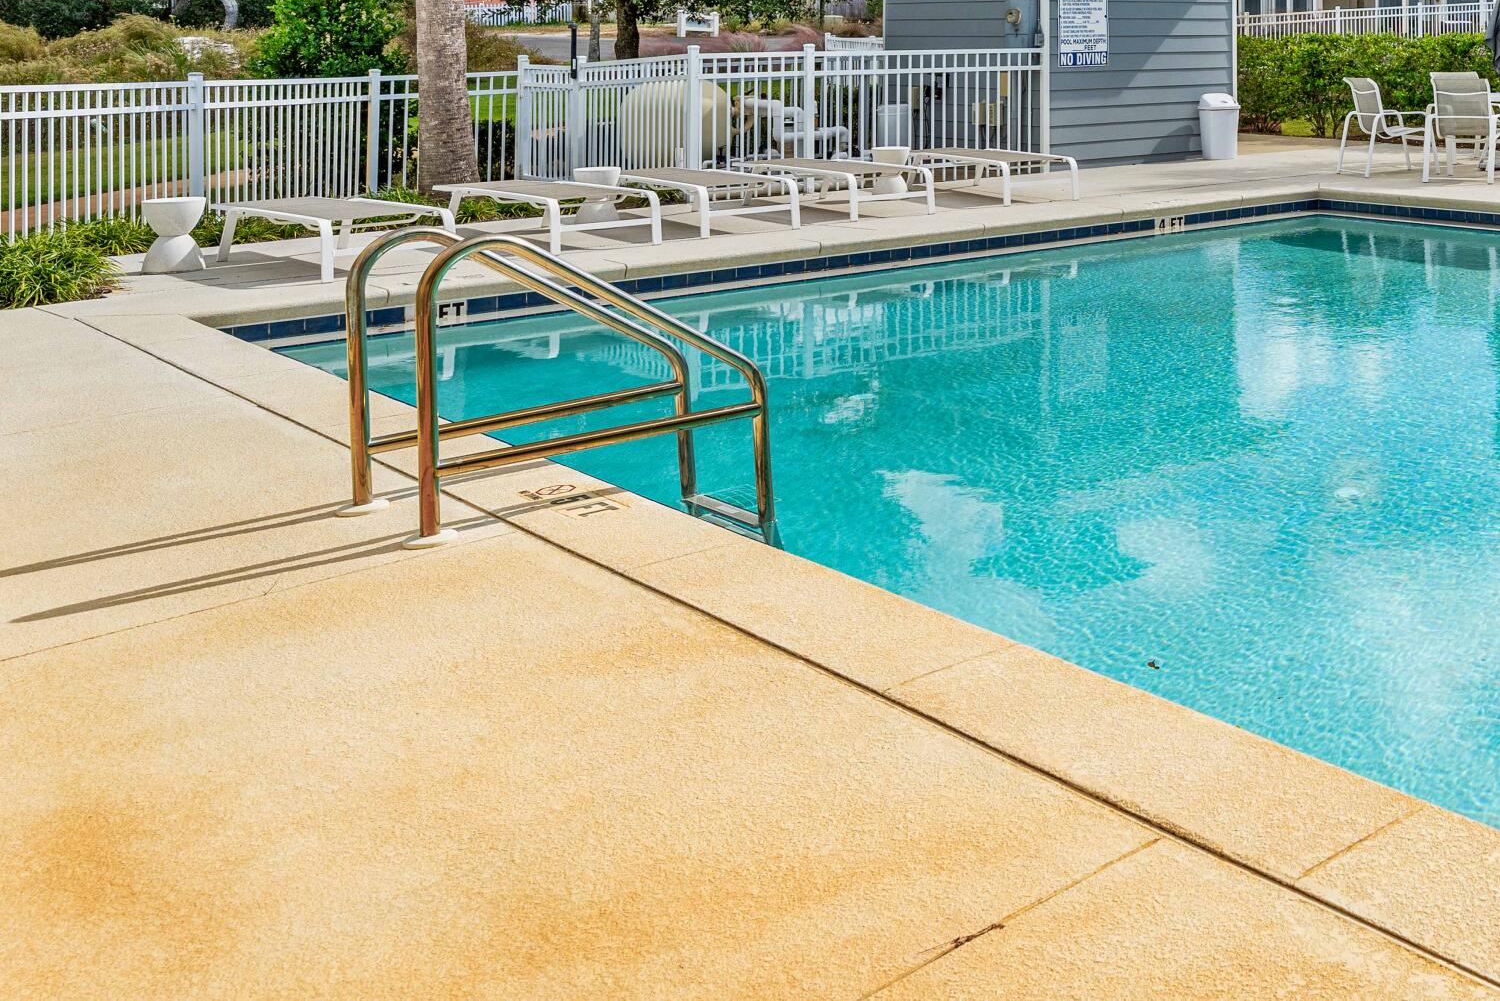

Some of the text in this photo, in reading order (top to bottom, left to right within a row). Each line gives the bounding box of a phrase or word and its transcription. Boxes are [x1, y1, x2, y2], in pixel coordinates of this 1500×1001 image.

[1060, 52, 1107, 66] NO DIVING
[1159, 216, 1184, 229] 4 FT
[438, 301, 465, 319] FT
[550, 494, 593, 505] 5
[565, 501, 620, 518] FT
